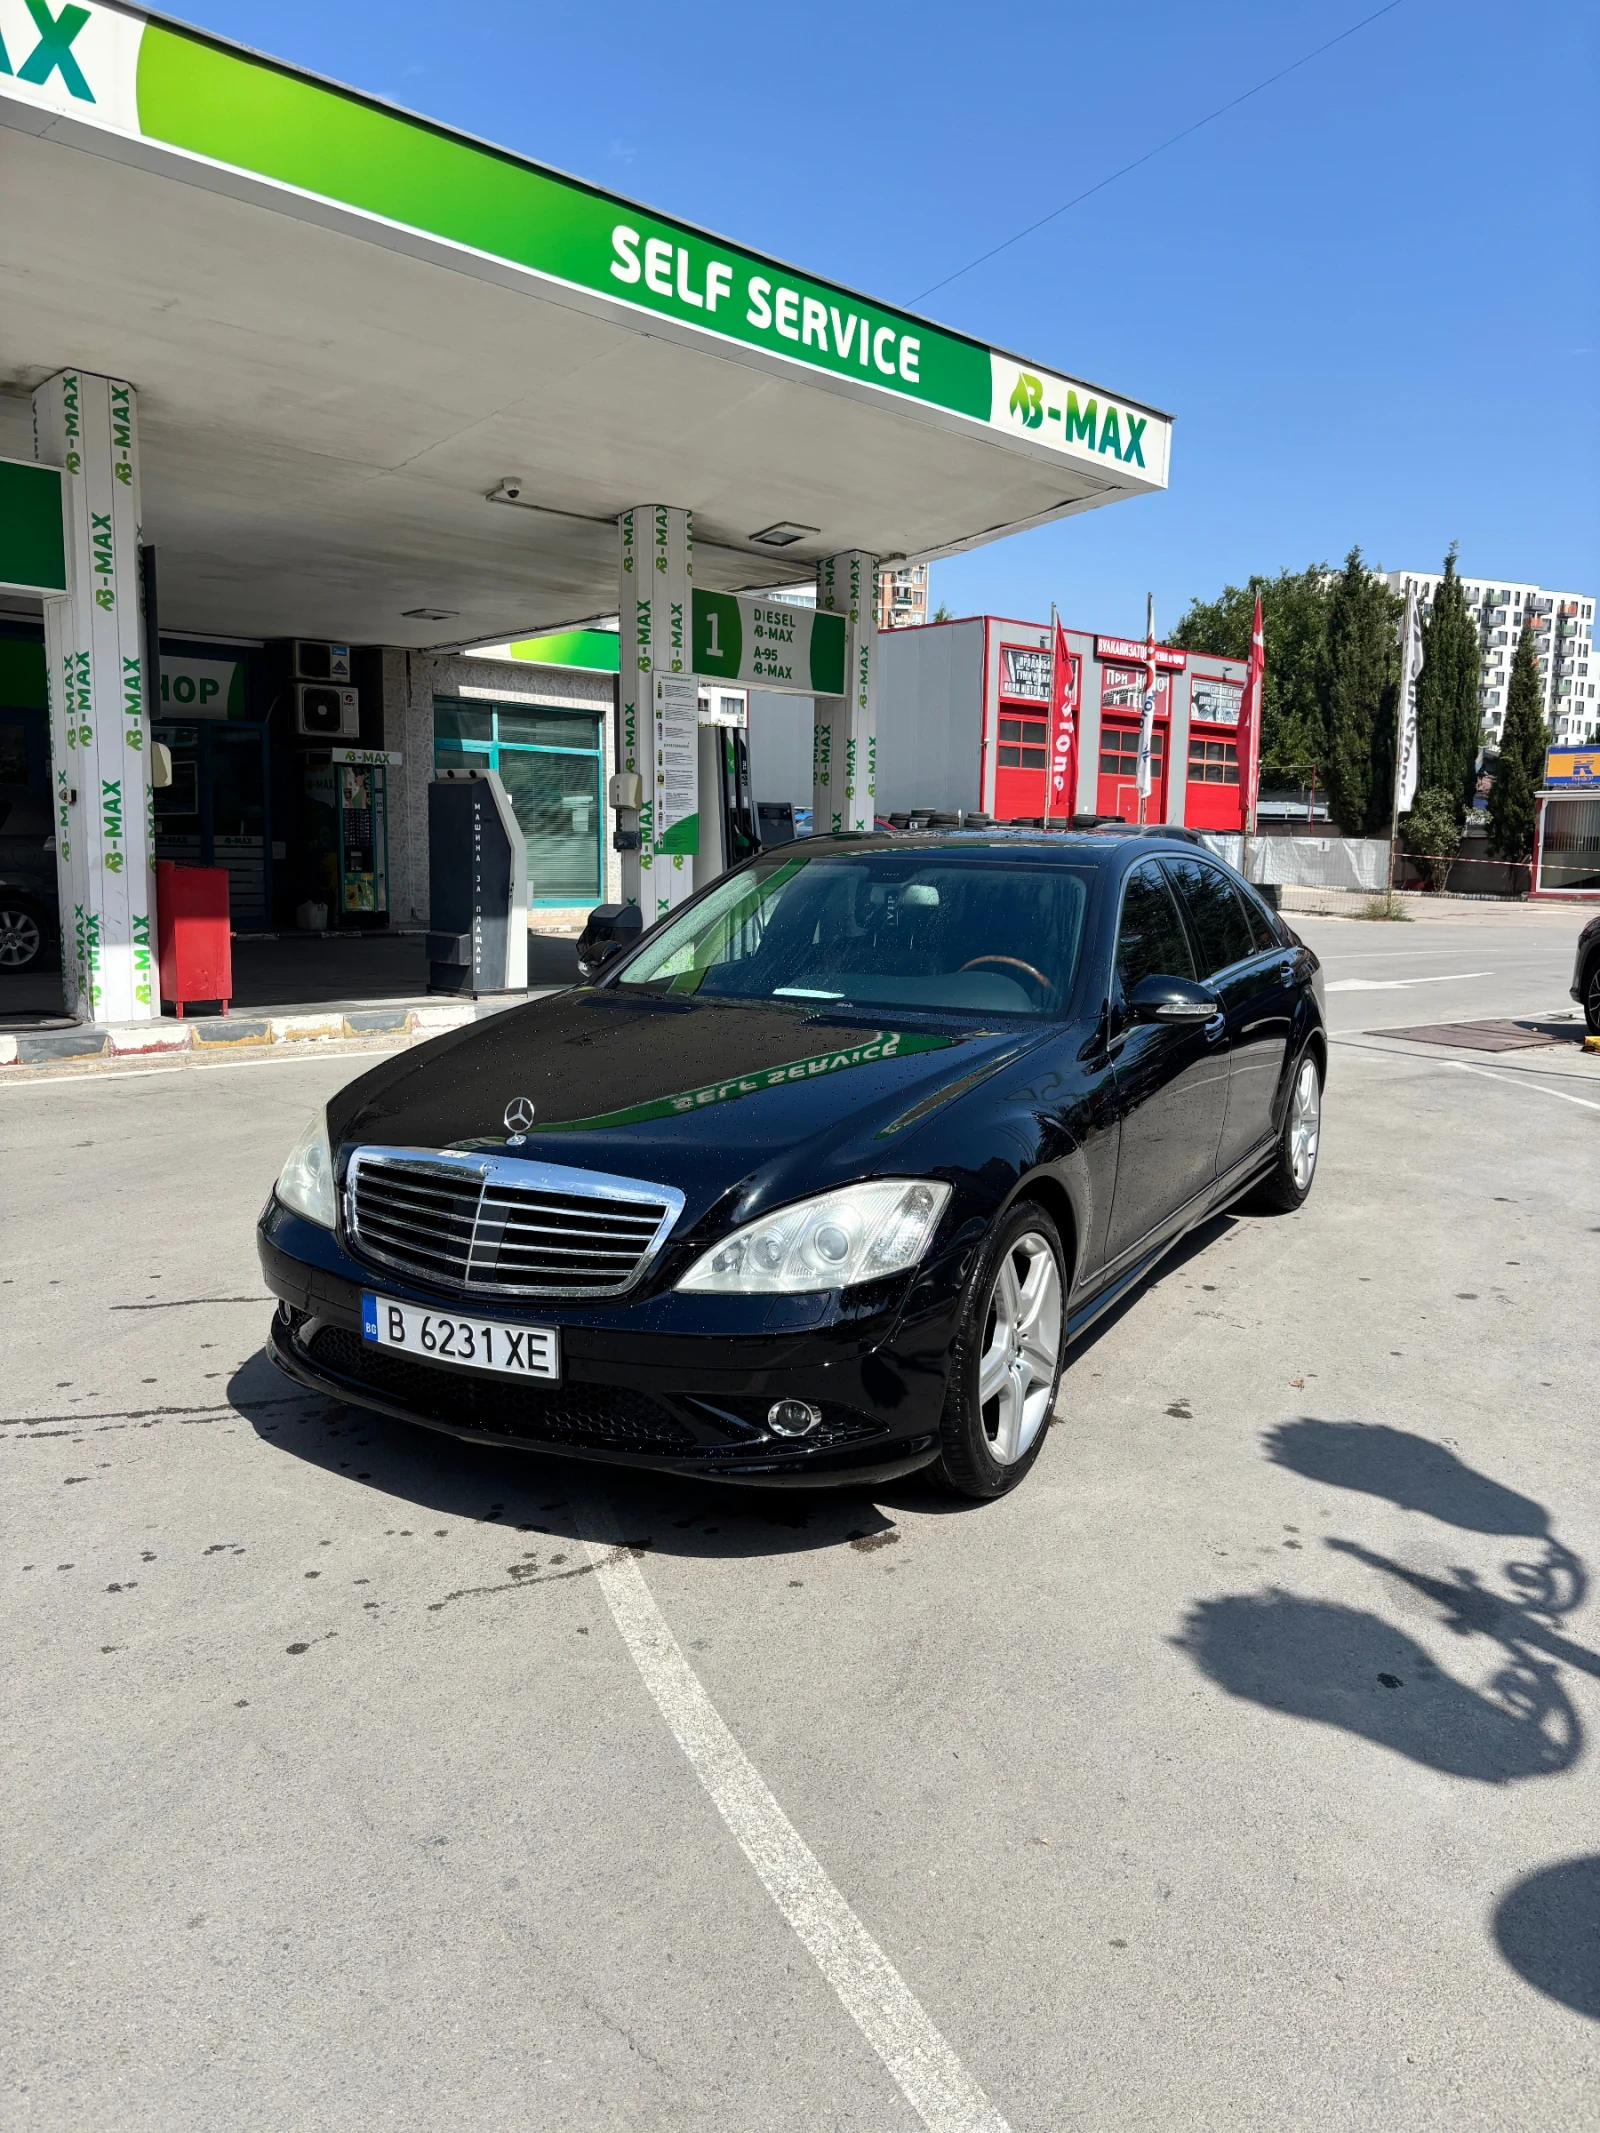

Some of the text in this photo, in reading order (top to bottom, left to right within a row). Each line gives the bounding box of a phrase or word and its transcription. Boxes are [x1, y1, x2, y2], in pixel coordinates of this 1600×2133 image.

[610, 224, 921, 384] SELF SERVICE
[753, 608, 797, 628] DIESEL
[705, 612, 724, 658] 1
[753, 645, 779, 662] A-95
[1106, 669, 1128, 685] При
[474, 803, 482, 862] МАШИНА
[475, 875, 481, 892] ЗА
[365, 1322, 378, 1335] BG
[388, 1306, 550, 1372] B 6231 XE
